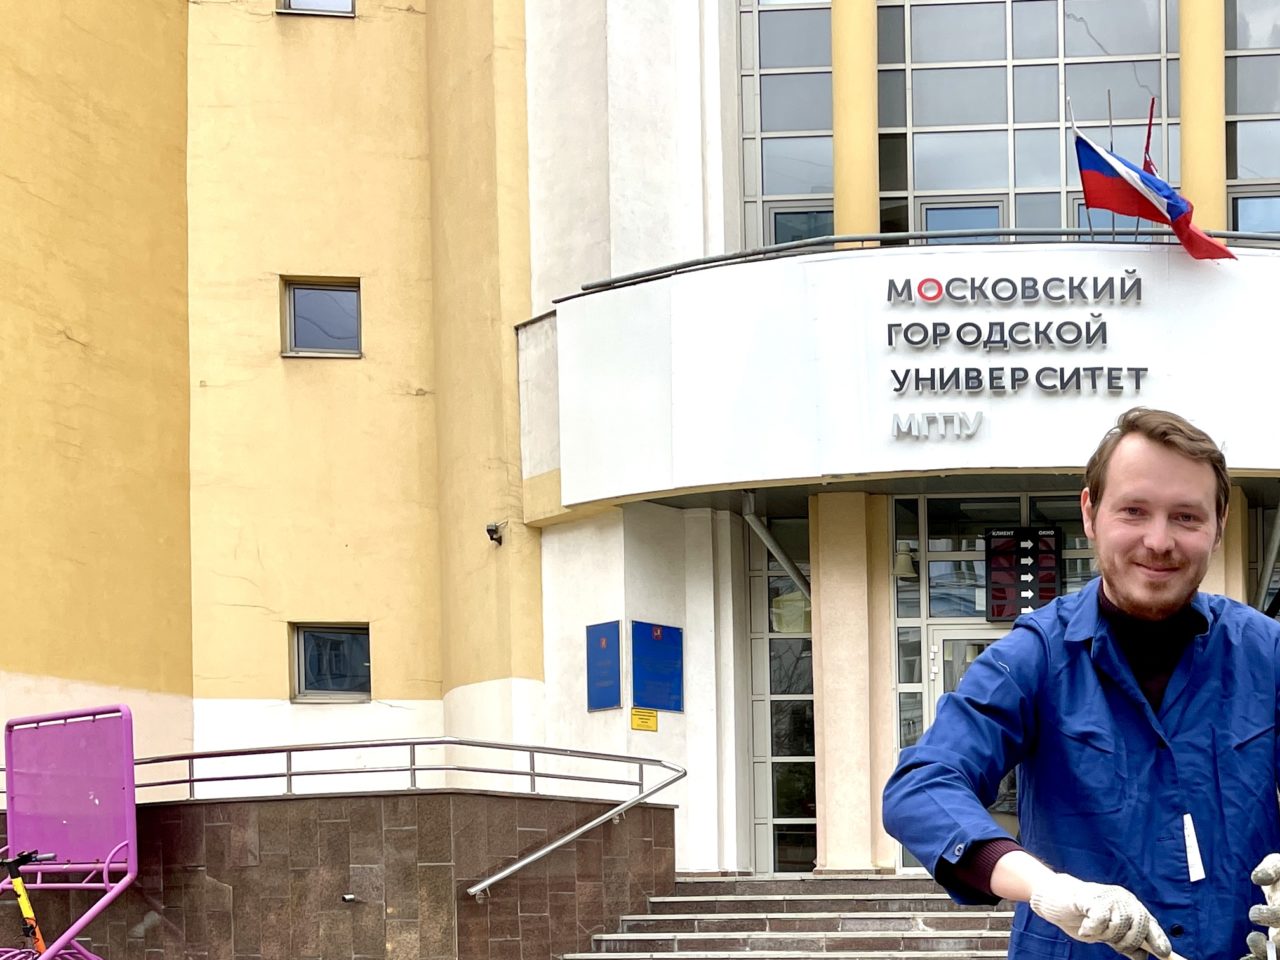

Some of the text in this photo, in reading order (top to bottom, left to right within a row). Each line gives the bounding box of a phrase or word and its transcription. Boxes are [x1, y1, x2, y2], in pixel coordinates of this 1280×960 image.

[887, 269, 1143, 302] МОСКОВСКИЙ
[887, 313, 1108, 349] ГОРОДСКОЙ
[890, 366, 1149, 393] УНИВЕРСИТЕТ
[892, 411, 984, 438] МГПУ
